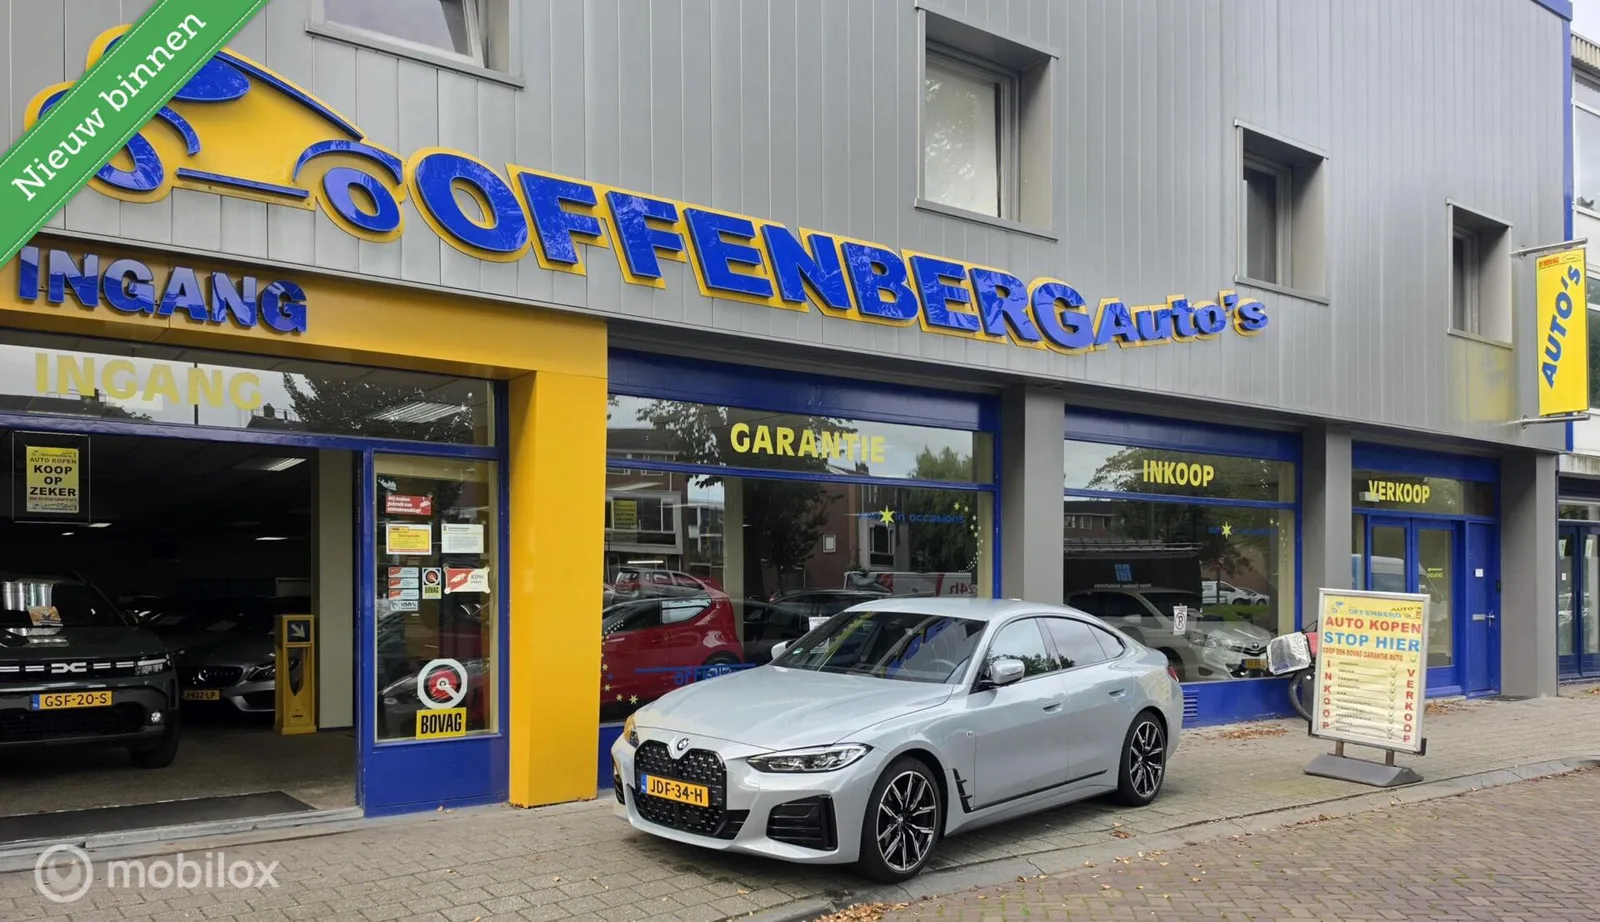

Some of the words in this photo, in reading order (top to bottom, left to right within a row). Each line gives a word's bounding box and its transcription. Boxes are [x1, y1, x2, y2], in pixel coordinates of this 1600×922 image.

[413, 152, 1097, 350] OFFENBERG
[1093, 292, 1269, 346] Auto's
[16, 245, 308, 333] INGANG
[1541, 264, 1582, 389] AUTO'S
[34, 352, 263, 411] INGANG
[729, 421, 887, 464] GARANTIE
[33, 465, 73, 475] KOOP
[44, 476, 63, 485] OP
[1142, 459, 1215, 487] INKOOP
[29, 486, 77, 497] ZEKER
[1368, 479, 1431, 504] VERKOOP
[909, 512, 966, 524] occasions
[1325, 616, 1365, 629] AUTO
[1369, 620, 1422, 634] KOPEN
[1324, 631, 1369, 647] STOP
[1375, 636, 1421, 652] HIER
[44, 693, 108, 708] GSF-20-S
[420, 713, 463, 734] BOVAG
[649, 776, 704, 804] JDF-34-H
